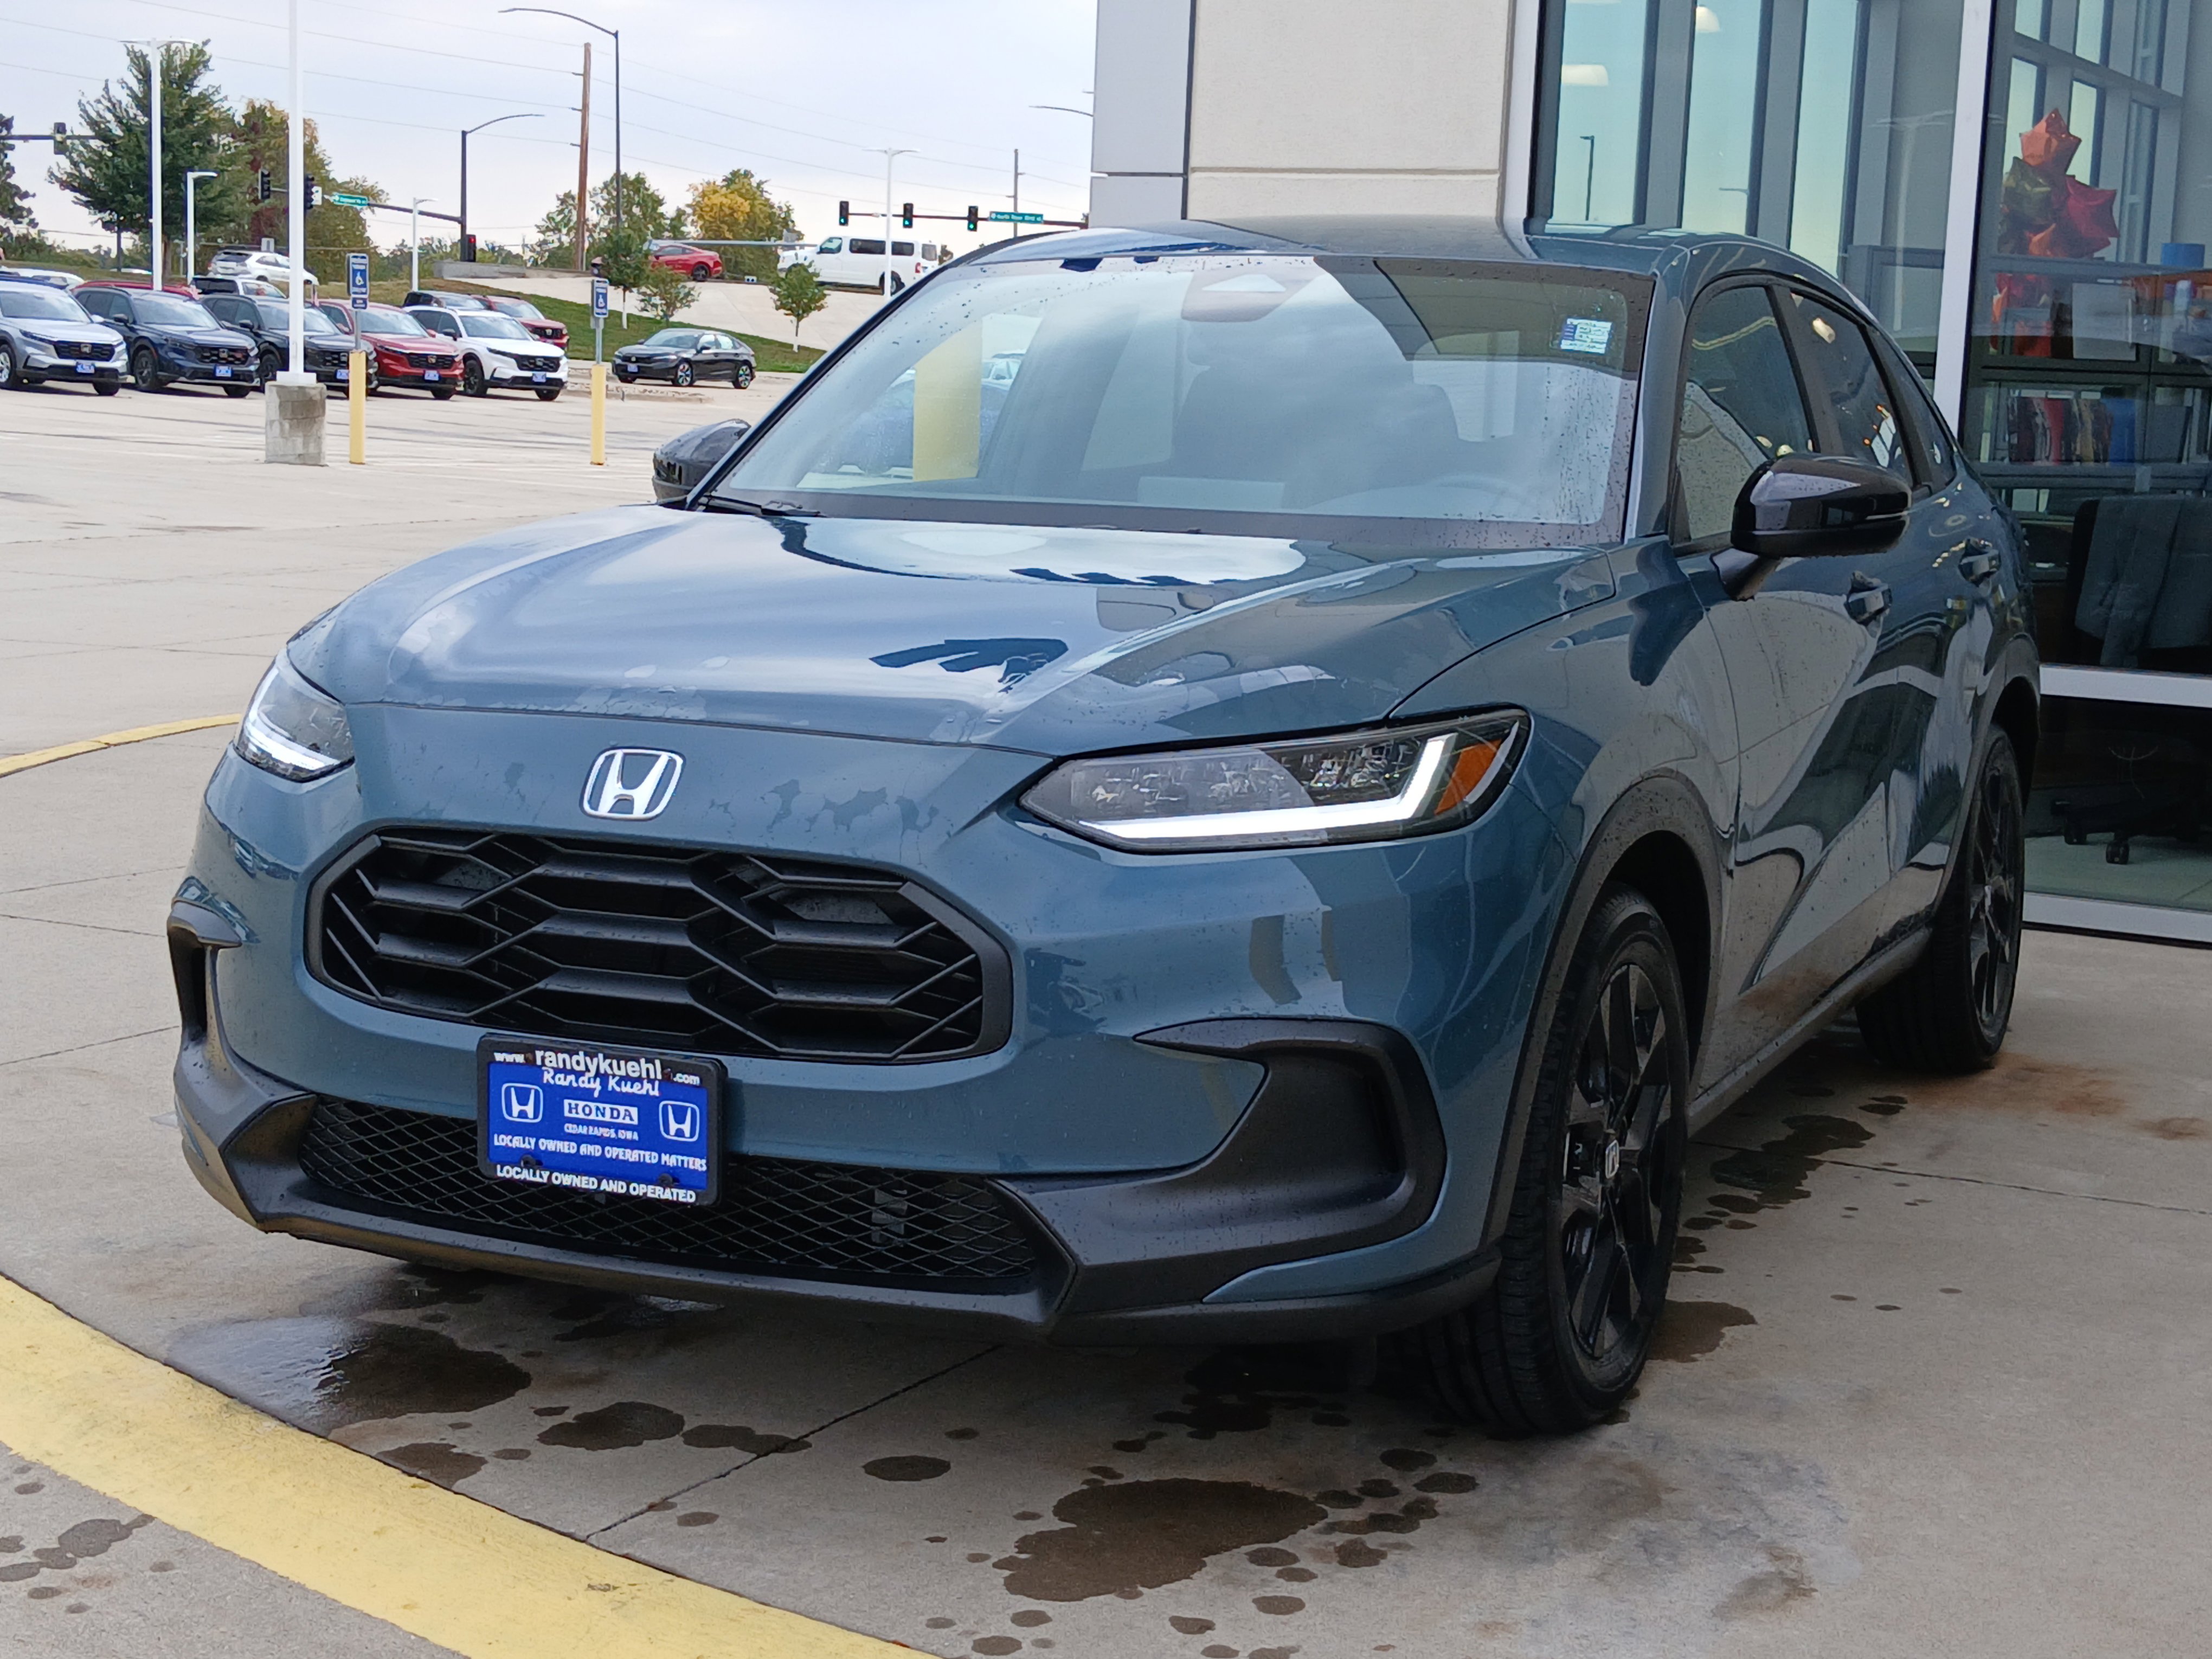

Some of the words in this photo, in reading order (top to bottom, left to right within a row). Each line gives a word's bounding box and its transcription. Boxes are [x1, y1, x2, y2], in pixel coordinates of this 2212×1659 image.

[535, 1050, 662, 1079] randykuehl
[542, 1067, 601, 1098] Randy
[608, 1075, 660, 1097] Kuehl
[567, 1102, 634, 1122] HONDA
[494, 1133, 536, 1150] LOCALLY
[539, 1138, 577, 1154] OWNED
[580, 1143, 602, 1156] AND
[605, 1146, 659, 1163] OPERATED
[661, 1153, 707, 1172] MATTERS
[497, 1164, 550, 1183] LOCALLY
[551, 1172, 598, 1189] OWNED
[600, 1179, 627, 1193] AND
[629, 1183, 696, 1203] OPERATED
